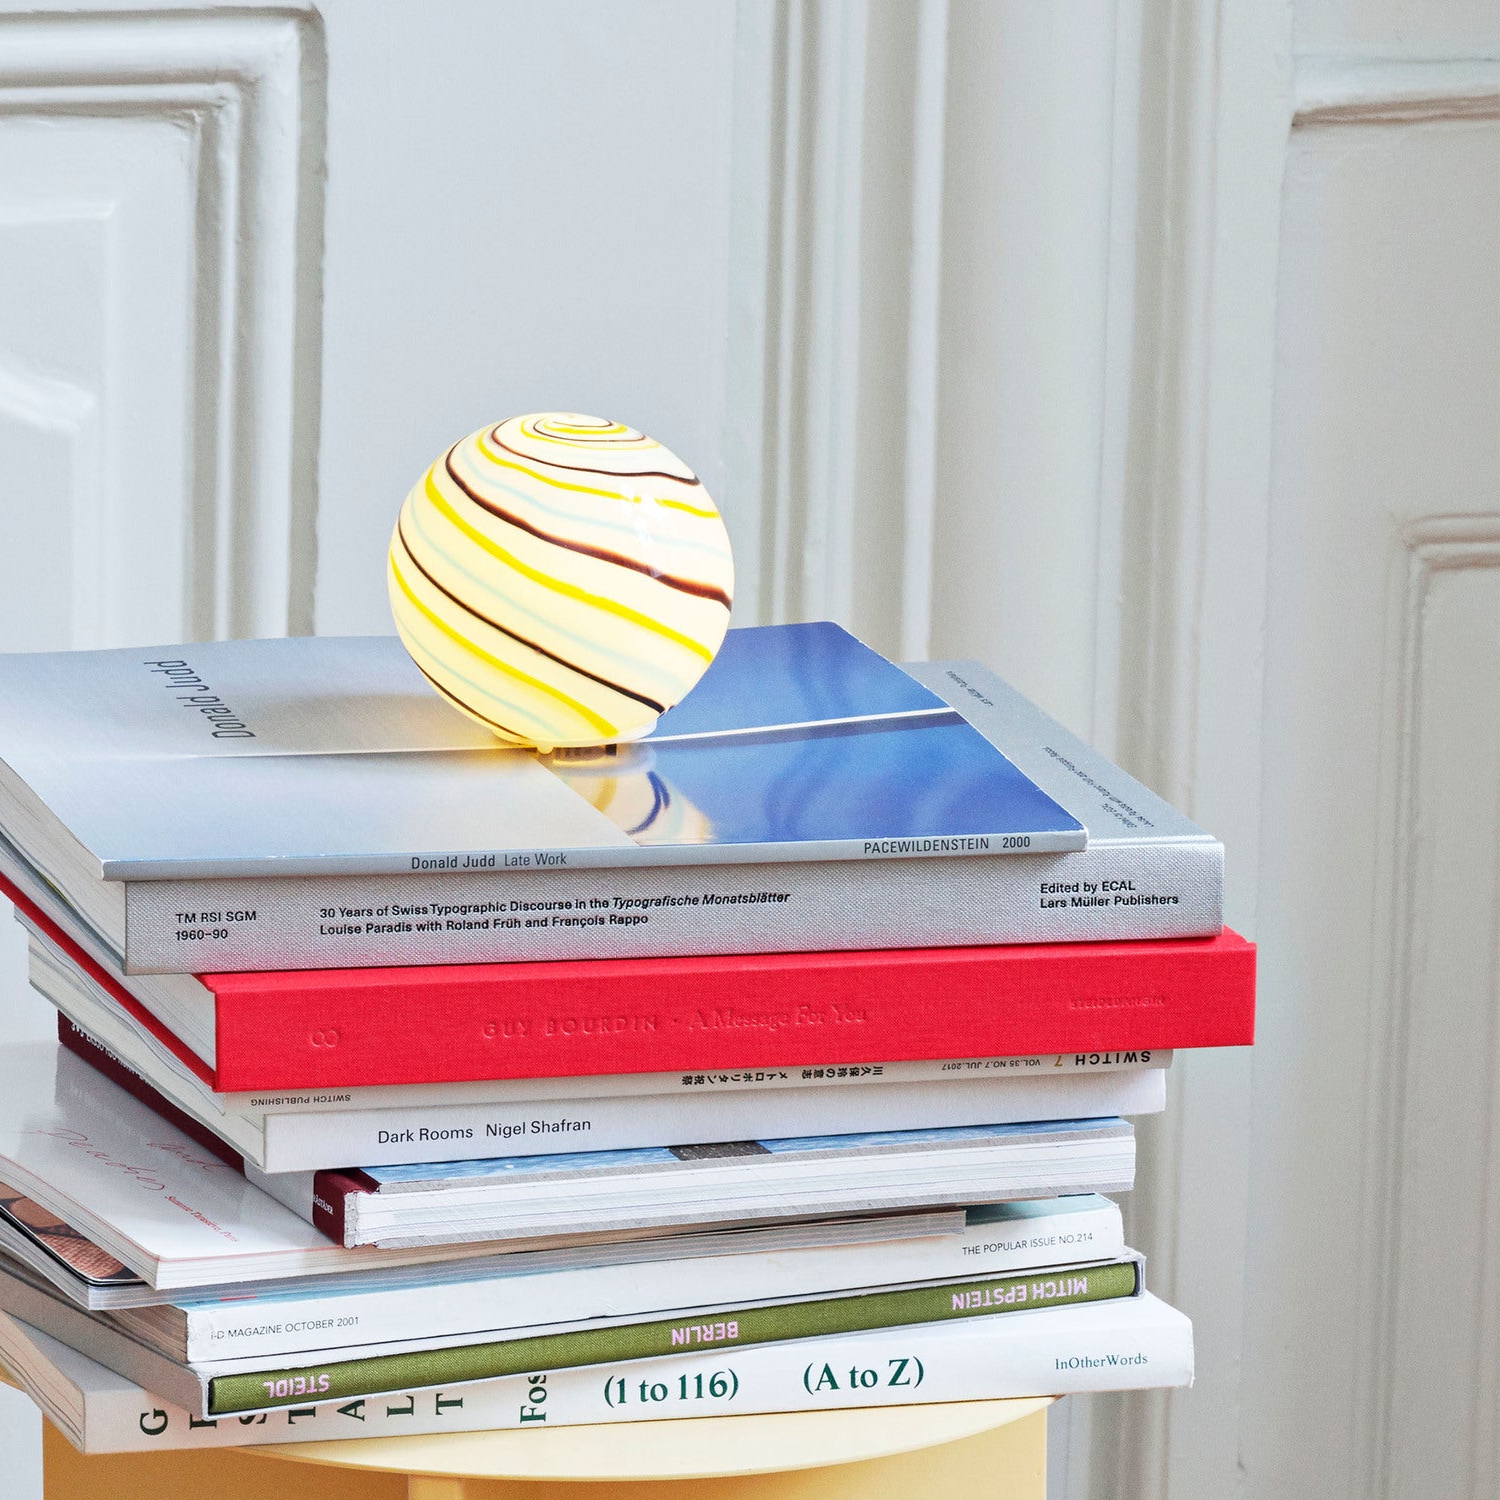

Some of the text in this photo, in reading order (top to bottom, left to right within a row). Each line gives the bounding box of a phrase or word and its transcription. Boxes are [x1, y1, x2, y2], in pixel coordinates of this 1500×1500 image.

[143, 660, 256, 738] Donald Judd
[864, 836, 1031, 854] PACEWILDENSTEIN 2000
[411, 852, 567, 870] Donald Judd Late Work
[1040, 881, 1136, 894] Edited by ECAL
[320, 892, 790, 918] 30 Years of Swiss Typographic Discourse in the Typografische Monatsblätter
[1040, 895, 1179, 908] Lars Müller Publishers
[175, 911, 257, 923] TM RSI SGM
[320, 914, 649, 935] Louise Paradis with Roland Früh and François Rappo
[482, 1018, 532, 1039] GUY
[545, 1014, 660, 1036] BOURDIN
[689, 1009, 709, 1031] A
[831, 1002, 868, 1024] You
[941, 1058, 1041, 1071] VOL.35 NO.7 JUL.2017
[1054, 1051, 1151, 1067] SWITCH 7
[251, 1094, 351, 1106] SWITCH PUBLISHING
[378, 1127, 474, 1144] Dark Rooms
[486, 1118, 591, 1139] Nigel Shafran
[962, 1232, 1093, 1256] THE POPULAR ISSUE NO.214
[952, 1276, 1088, 1311] MITCH EPSTEIN
[228, 1324, 282, 1339] MAGAZINE
[285, 1318, 334, 1333] OCTOBER
[337, 1316, 359, 1328] 2001
[671, 1320, 739, 1346] BERLIN
[1055, 1352, 1149, 1371] InOtherWords
[803, 1355, 925, 1395] (A to Z)
[263, 1373, 330, 1399] STEIDL
[604, 1368, 739, 1408] (1 to 116)
